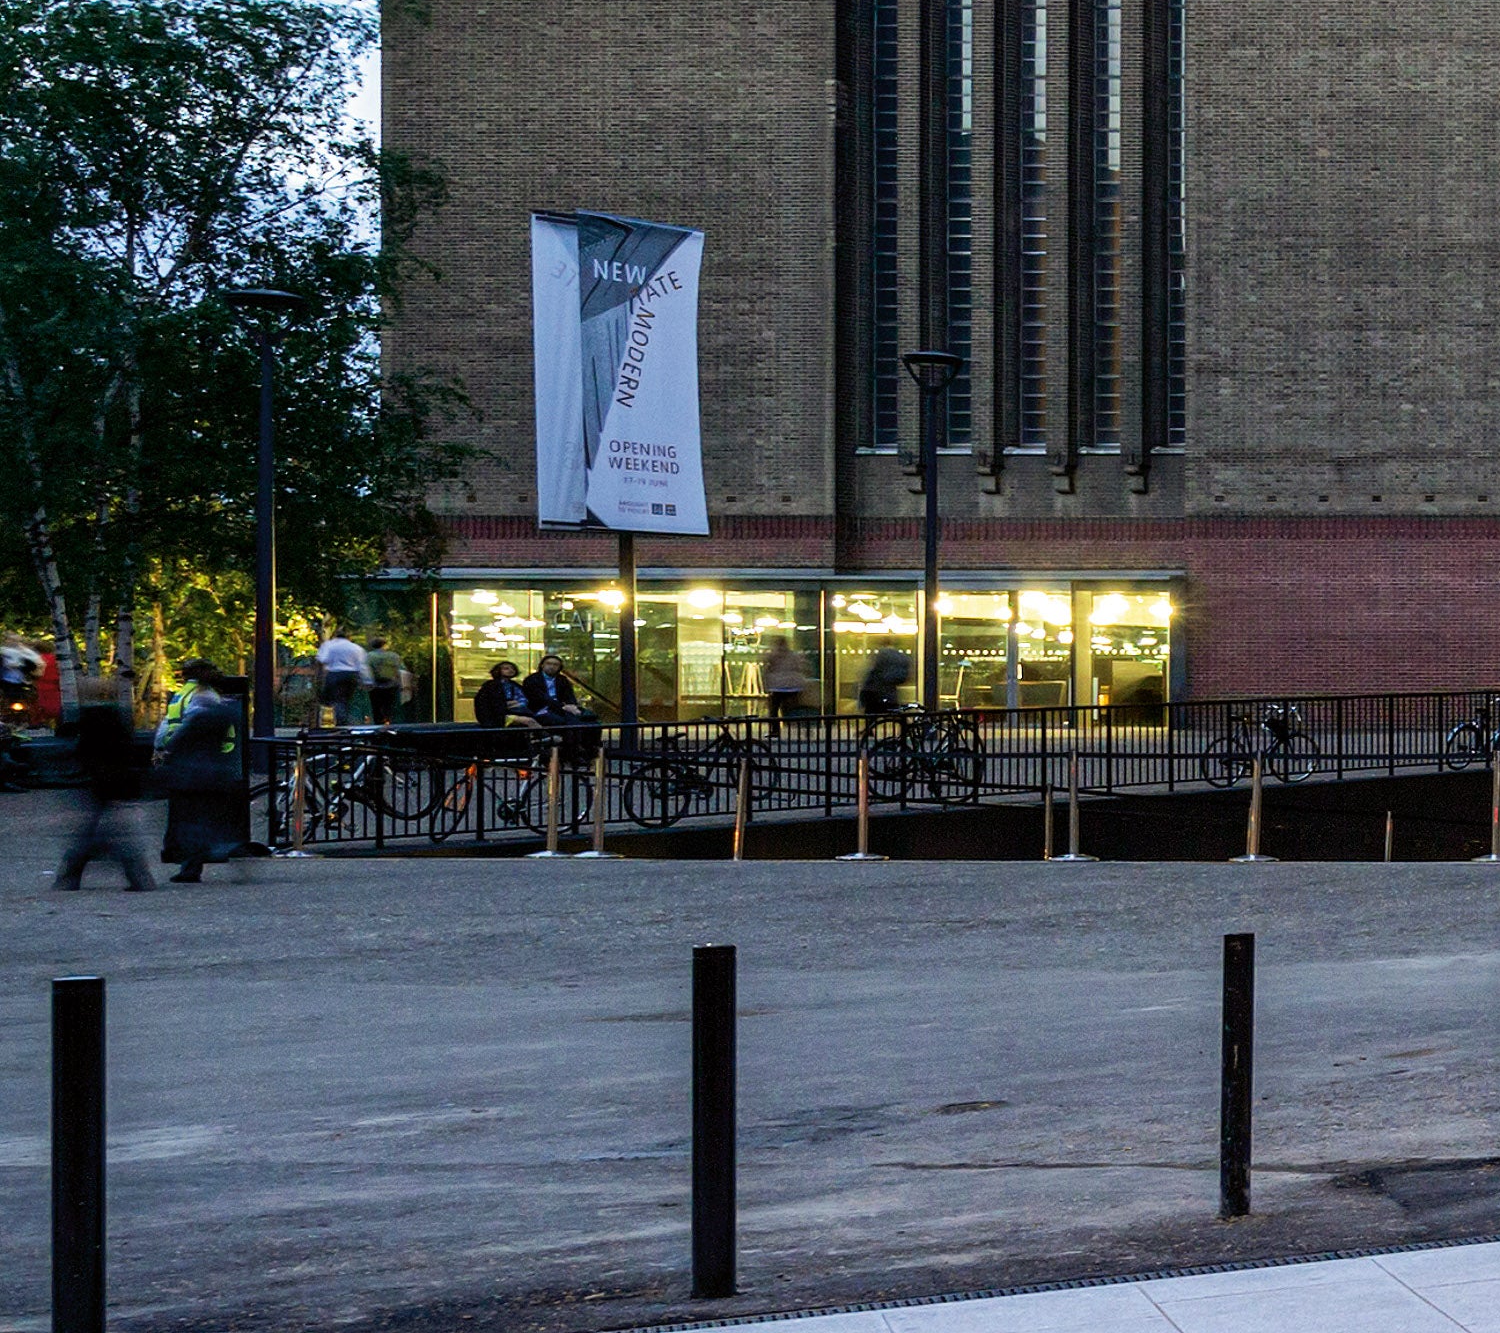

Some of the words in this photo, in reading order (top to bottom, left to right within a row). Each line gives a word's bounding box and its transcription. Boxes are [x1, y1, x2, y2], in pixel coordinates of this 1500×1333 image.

[593, 258, 647, 285] NEW
[629, 270, 683, 311] TATE
[615, 306, 656, 409] MODERN
[609, 440, 677, 459] OPENING
[609, 457, 680, 475] WEEKEND
